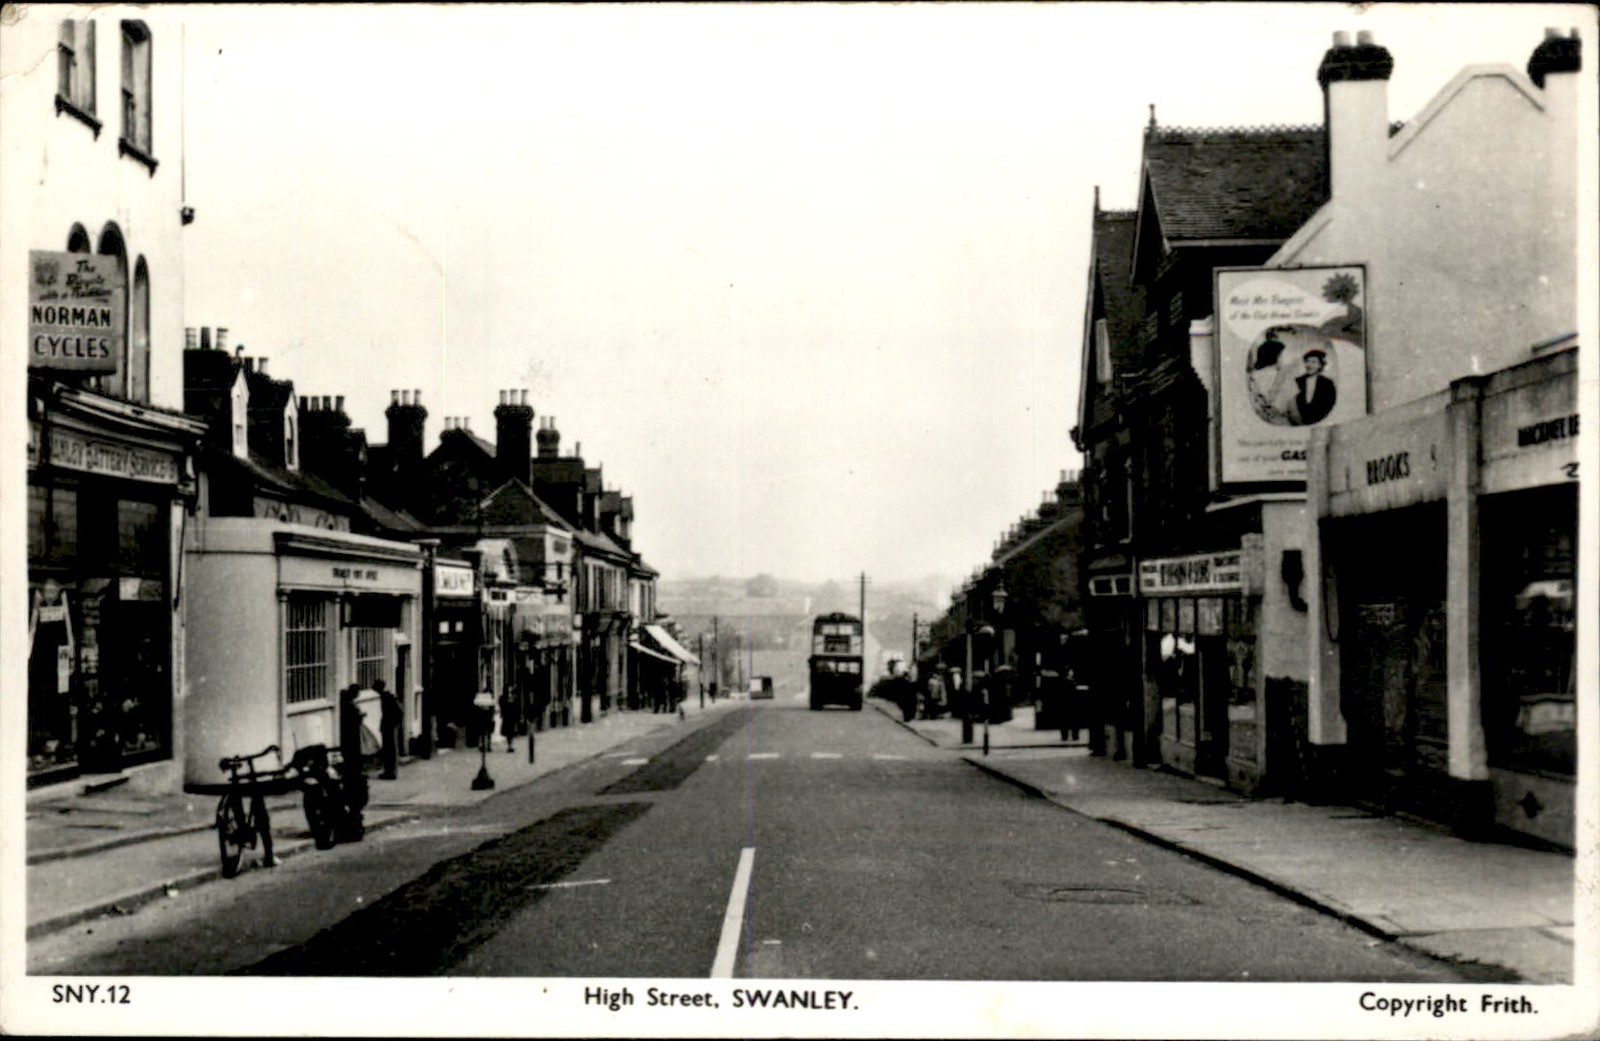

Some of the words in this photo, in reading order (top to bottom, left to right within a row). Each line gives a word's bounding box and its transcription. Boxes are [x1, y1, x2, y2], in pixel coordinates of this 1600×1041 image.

[77, 260, 96, 273] The
[32, 305, 111, 328] NORMAN
[33, 335, 110, 359] CYCLES
[1366, 451, 1410, 486] BROOKS
